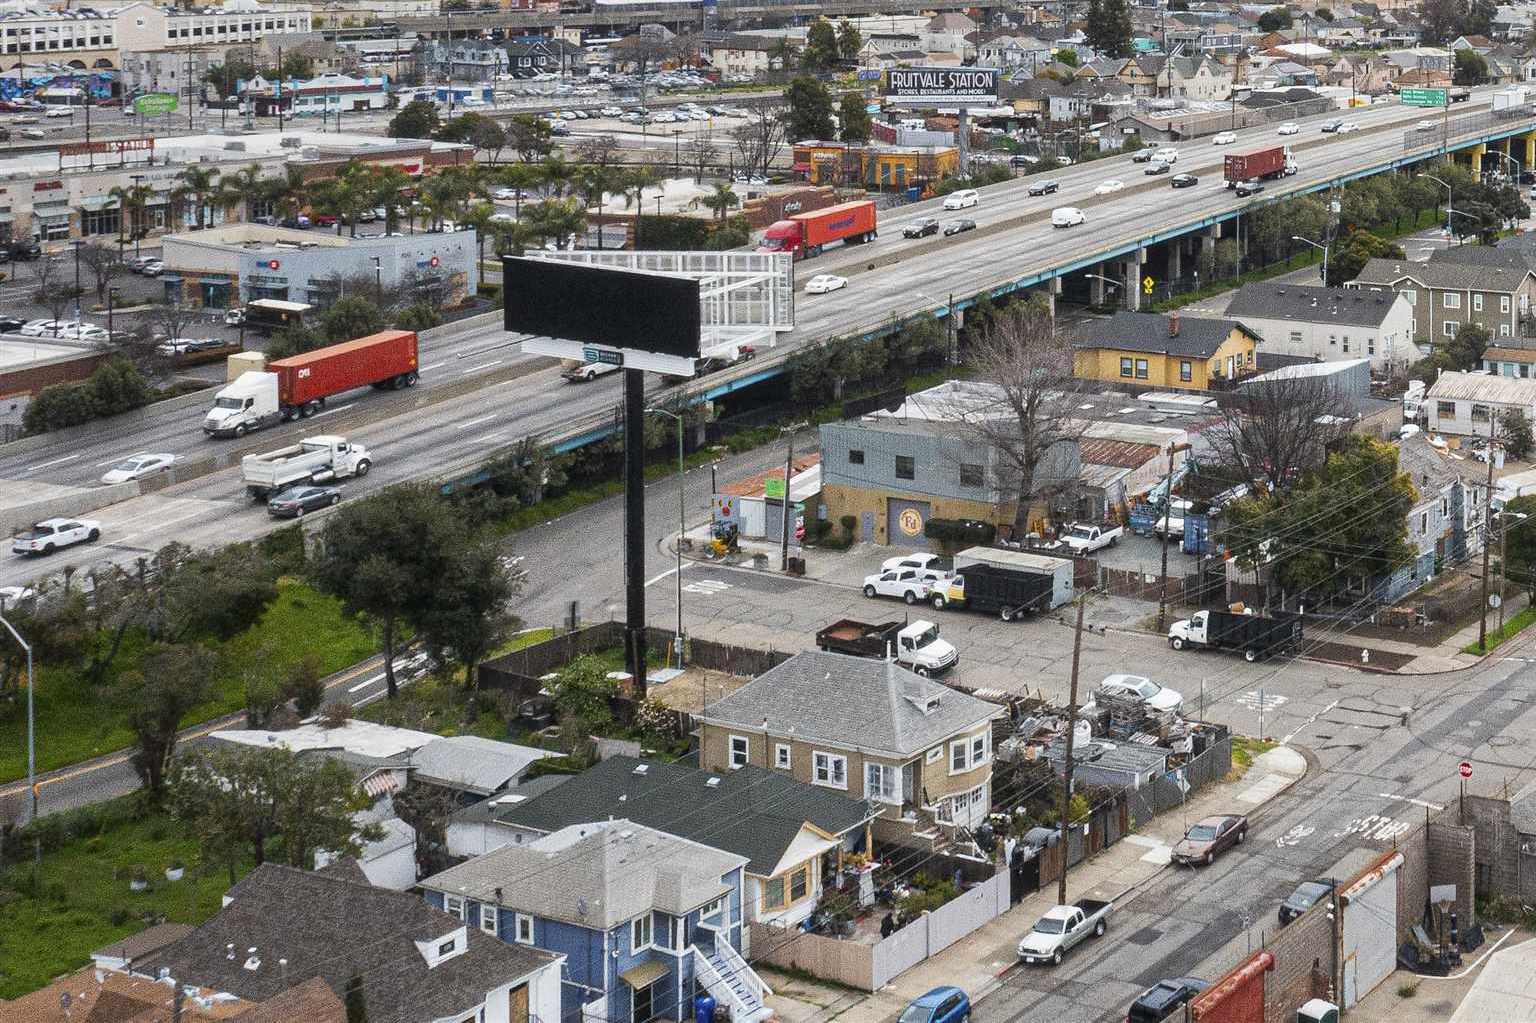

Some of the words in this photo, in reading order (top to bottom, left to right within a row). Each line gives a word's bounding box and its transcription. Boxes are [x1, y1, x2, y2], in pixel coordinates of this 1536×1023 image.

[891, 72, 945, 89] FRUITVALE
[948, 72, 993, 89] STATION
[1459, 765, 1473, 775] STOP
